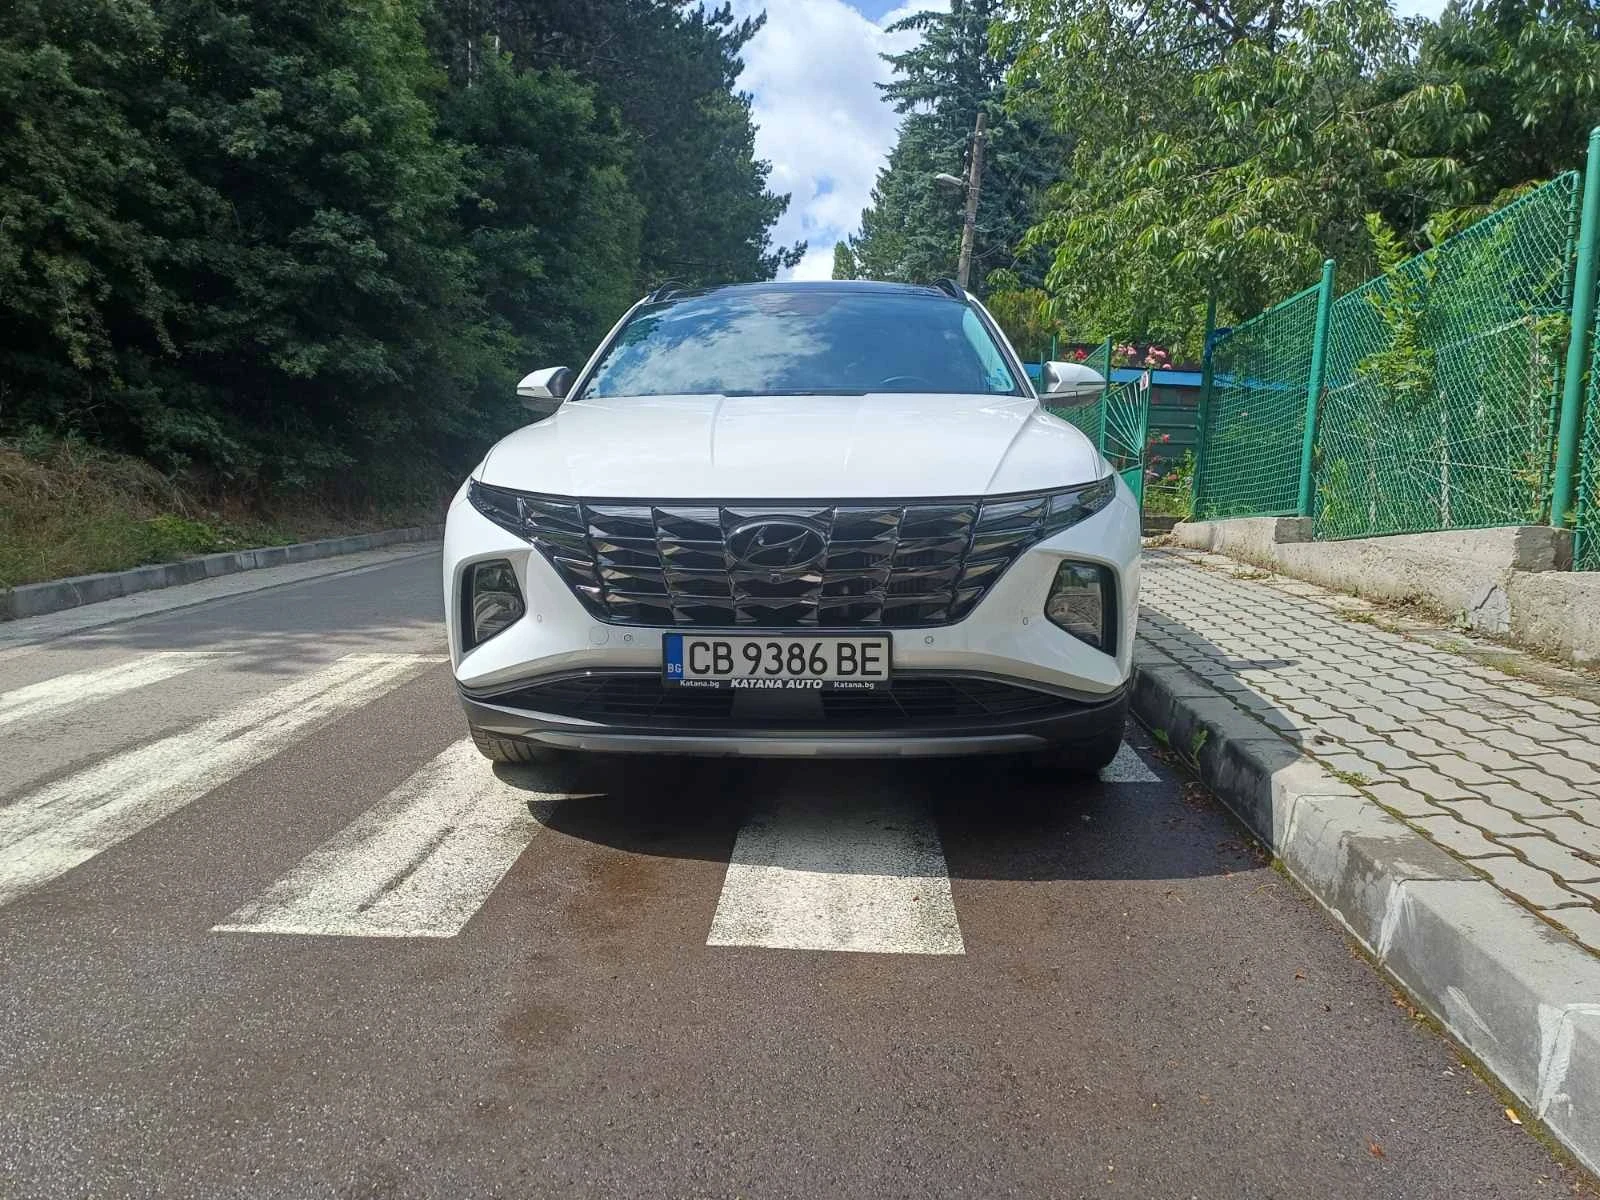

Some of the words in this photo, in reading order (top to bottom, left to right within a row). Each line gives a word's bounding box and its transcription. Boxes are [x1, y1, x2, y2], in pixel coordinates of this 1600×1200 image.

[688, 641, 734, 675] CB
[742, 642, 828, 676] 9386
[836, 642, 883, 676] BE
[667, 663, 682, 673] BG
[680, 680, 720, 688] Katana.bg
[730, 679, 783, 689] KATANA
[786, 679, 823, 689] AUTO
[834, 681, 875, 690] Katana.bg
